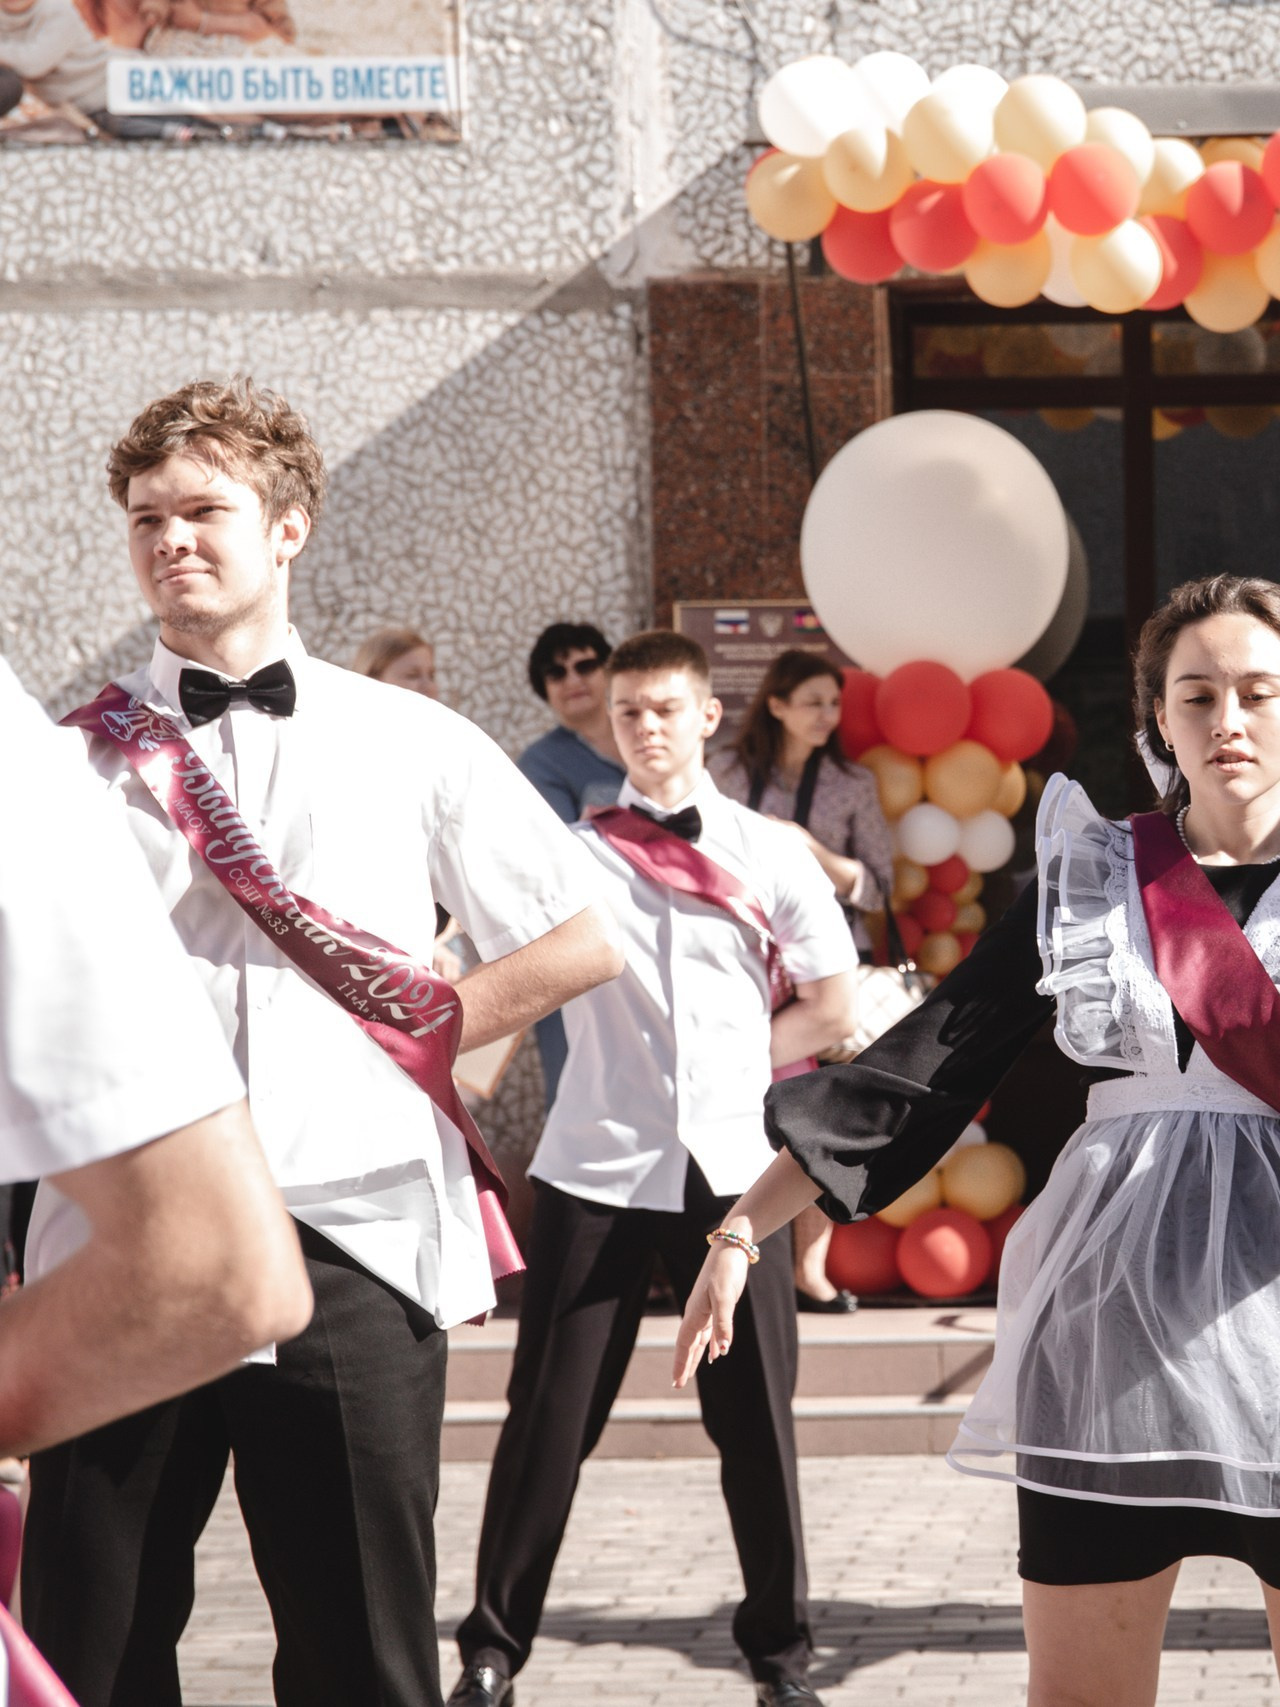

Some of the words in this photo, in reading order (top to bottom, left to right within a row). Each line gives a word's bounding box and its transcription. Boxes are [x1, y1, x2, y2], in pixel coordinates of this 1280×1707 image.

[128, 68, 233, 101] ВАЖНО
[243, 67, 323, 100] БЫТЬ
[332, 64, 446, 99] ВМЕСТЕ
[171, 797, 212, 836] МАОУ
[228, 868, 262, 904] СОШ
[256, 902, 289, 936] №33
[341, 947, 457, 1039] 2024
